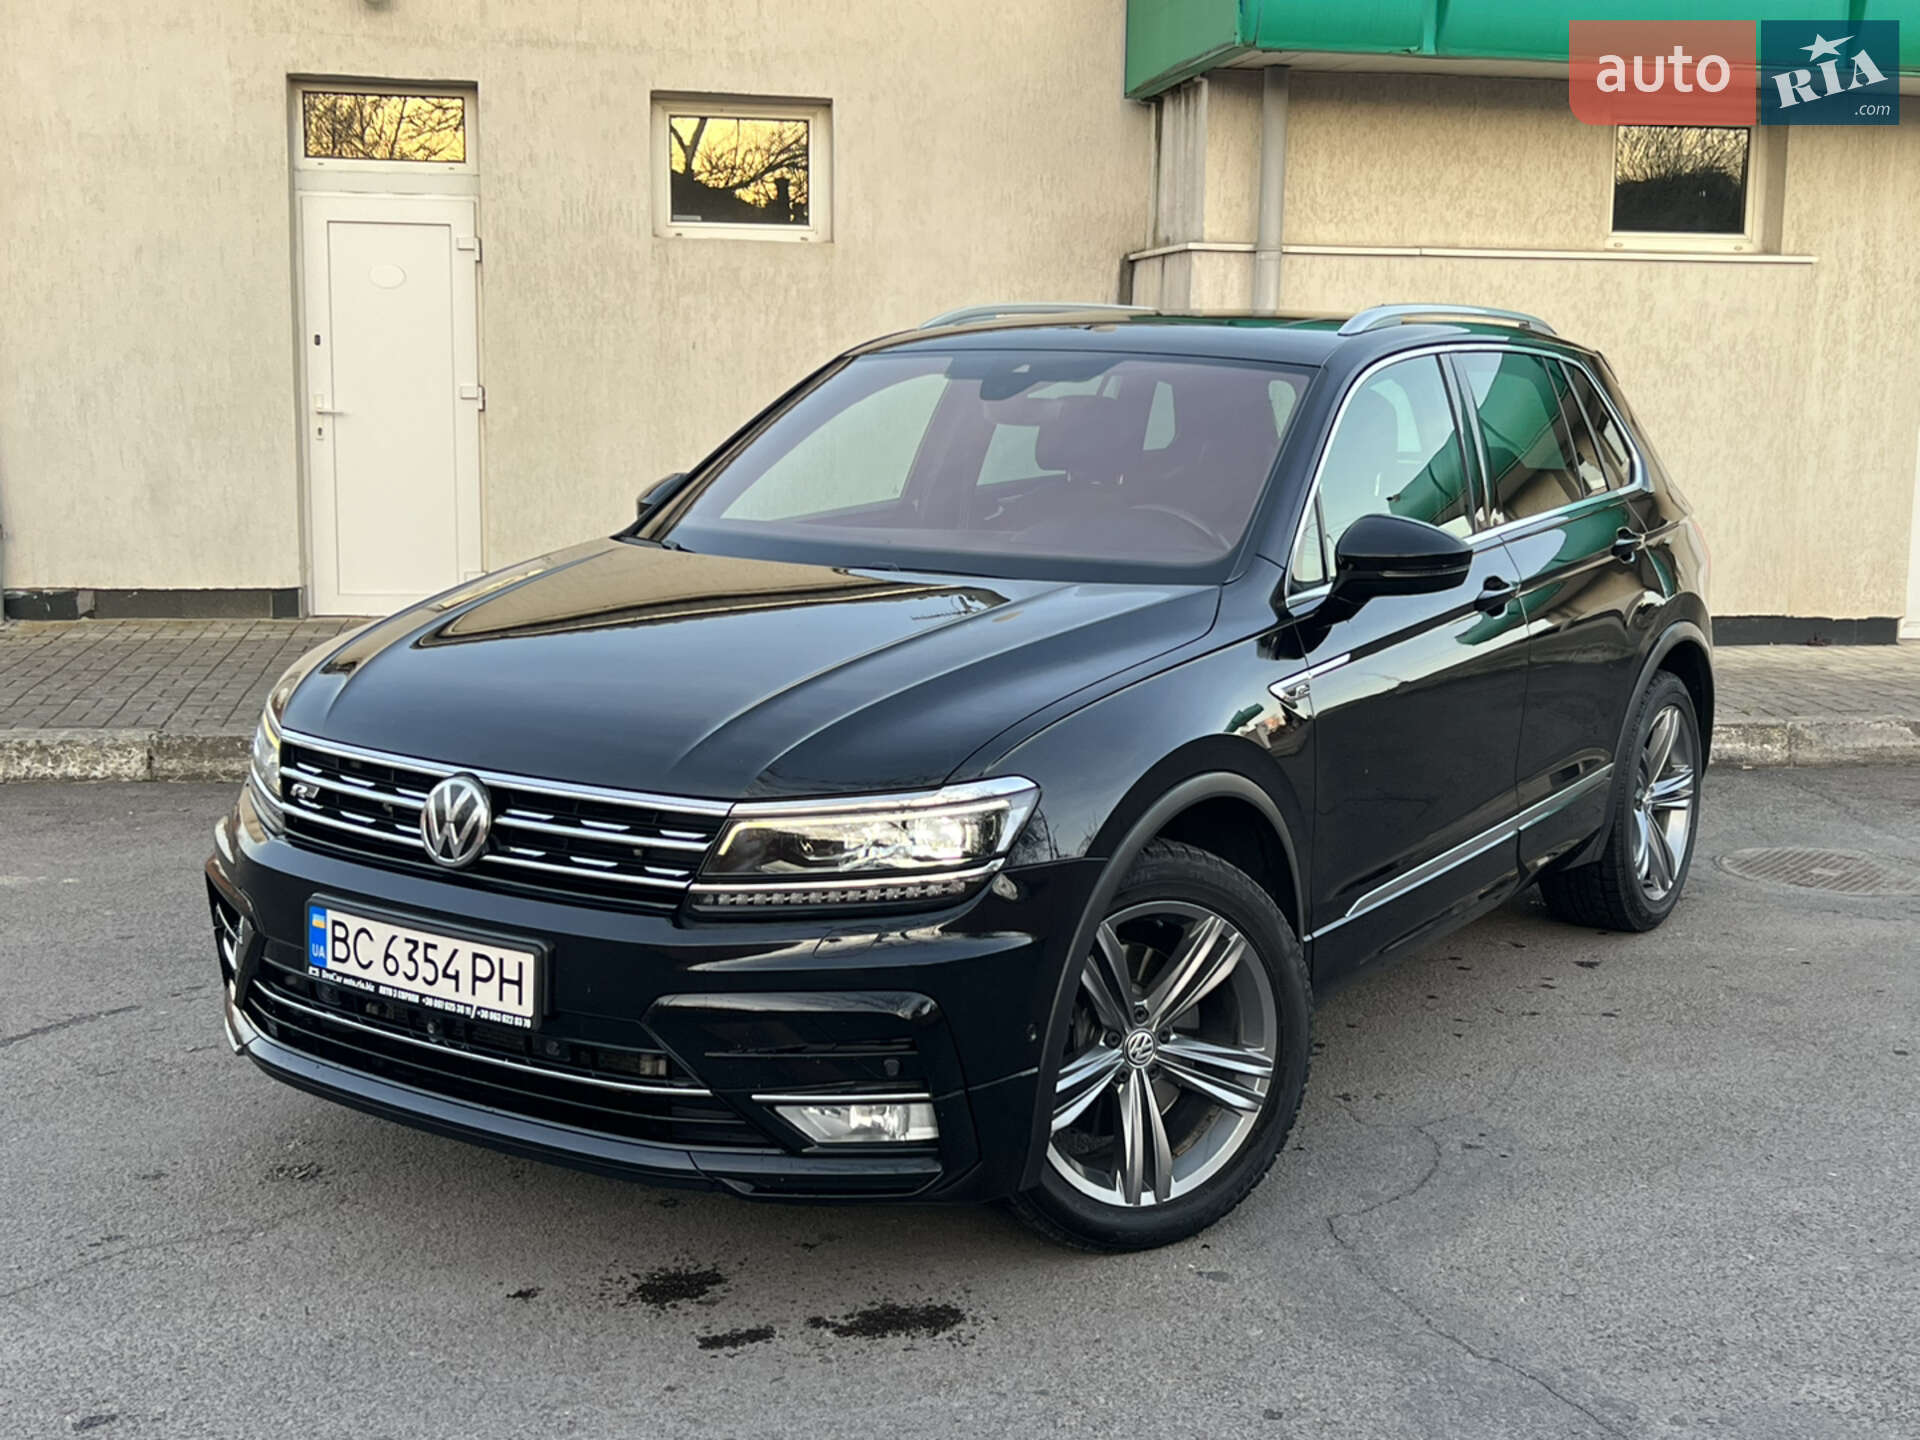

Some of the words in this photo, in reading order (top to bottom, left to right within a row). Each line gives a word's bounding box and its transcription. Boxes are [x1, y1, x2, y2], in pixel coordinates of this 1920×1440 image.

[311, 943, 326, 959] UA
[331, 919, 375, 970] BC
[383, 935, 460, 993] 6354
[471, 951, 523, 1006] PH
